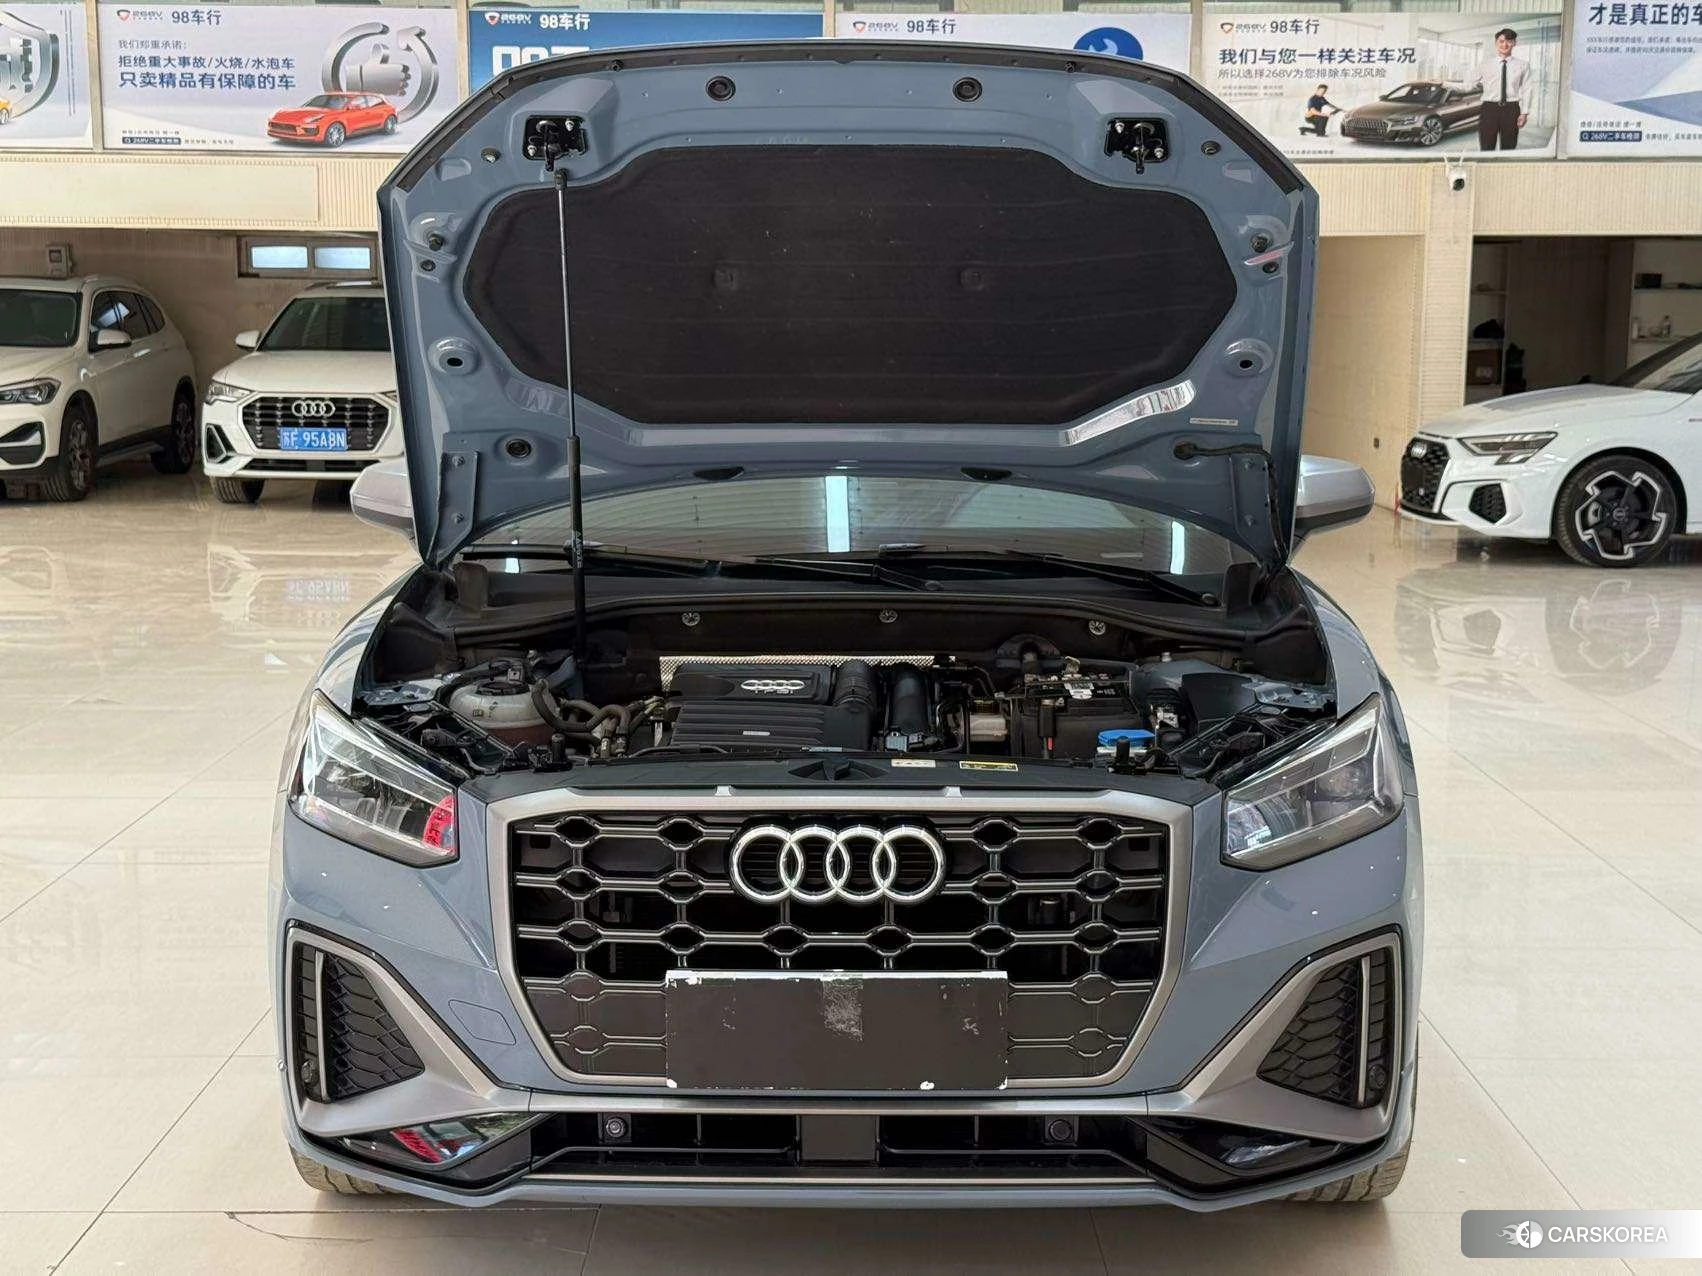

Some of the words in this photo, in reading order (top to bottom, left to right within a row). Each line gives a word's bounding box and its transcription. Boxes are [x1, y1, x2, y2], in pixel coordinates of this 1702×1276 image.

[171, 10, 222, 26] 98车行
[540, 13, 590, 30] 98车行
[1588, 3, 1702, 25] 才是真正的车
[907, 19, 956, 34] 98车行
[1270, 19, 1320, 34] 98车行
[118, 55, 296, 70] 拒绝重大事故/火烧/水泡车
[1219, 48, 1417, 65] 我们与您一样关注车况
[119, 72, 296, 90] 只卖精品有保障的车
